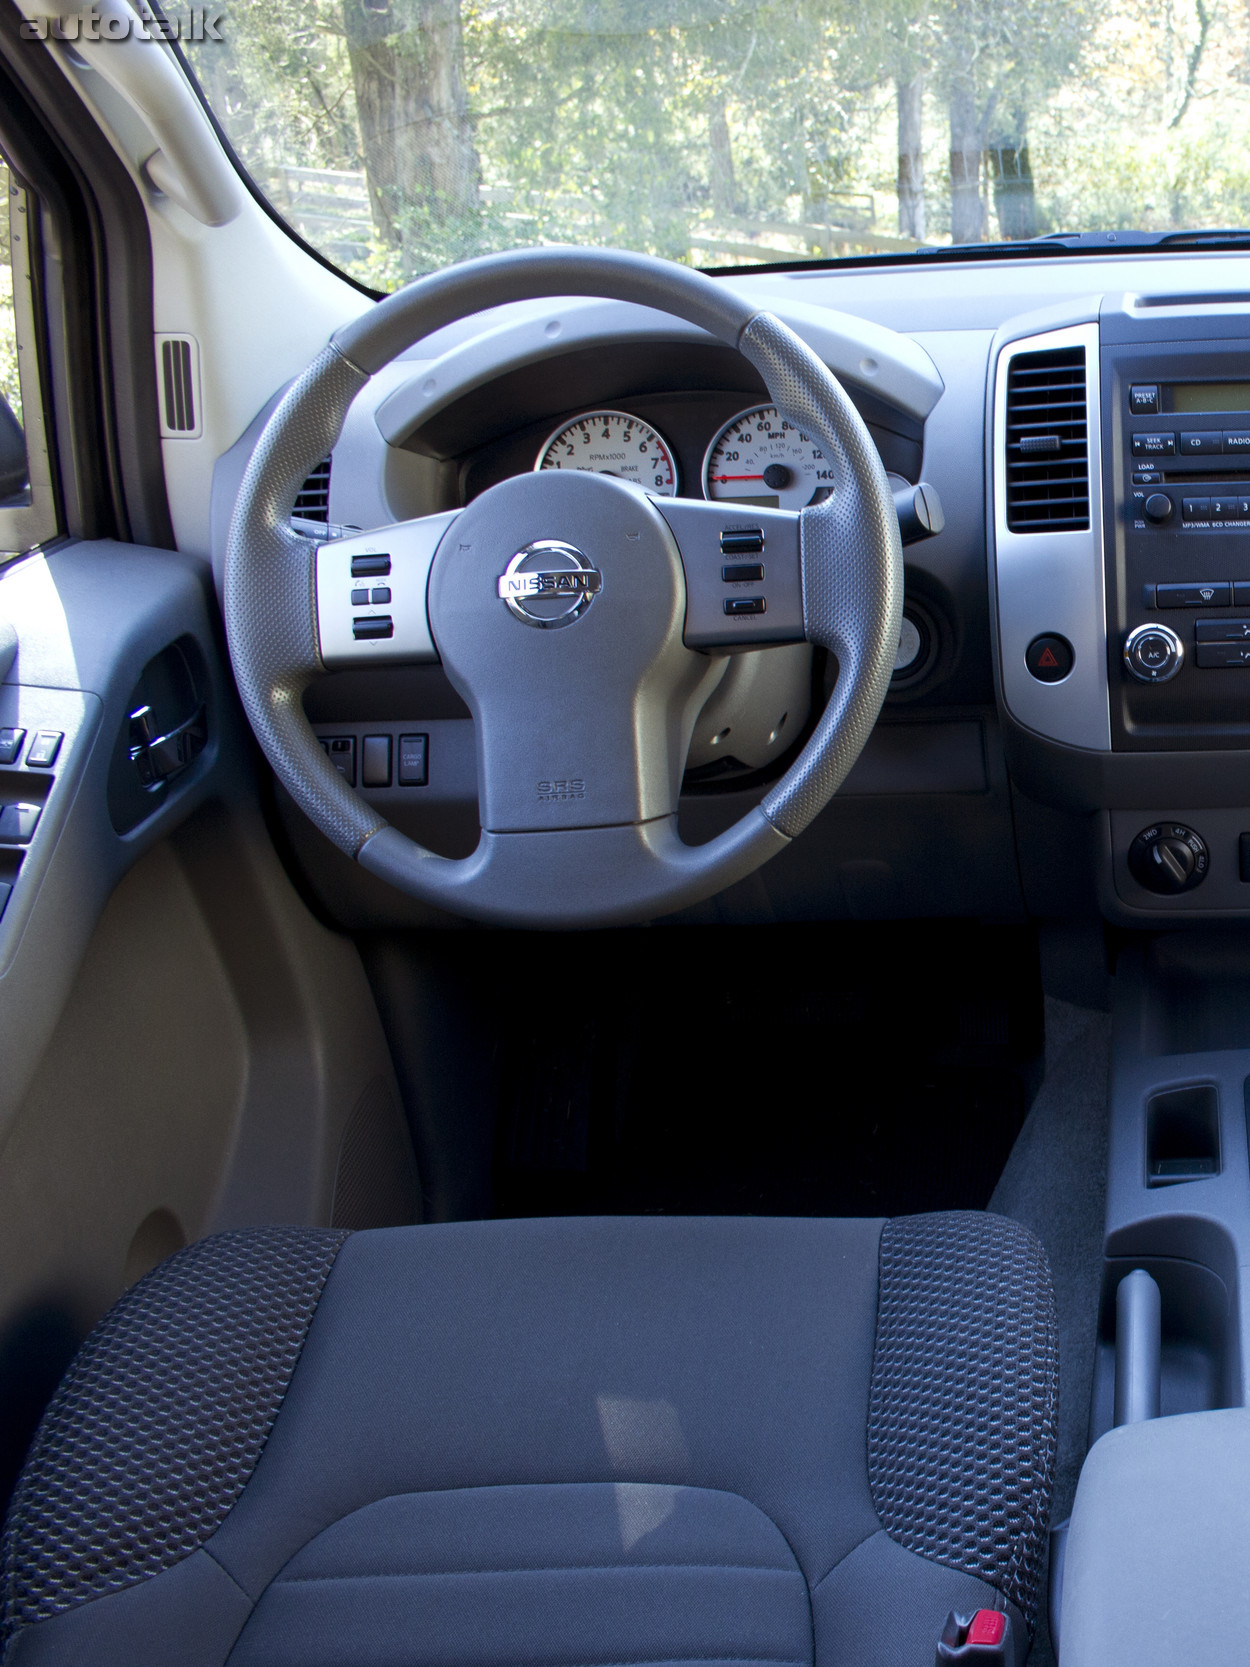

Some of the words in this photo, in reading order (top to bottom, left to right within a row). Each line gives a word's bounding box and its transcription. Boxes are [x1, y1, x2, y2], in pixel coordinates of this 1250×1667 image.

[757, 422, 771, 431] 60
[583, 433, 591, 444] 3
[602, 428, 610, 439] 4
[623, 431, 631, 442] 5
[738, 433, 752, 443] 40
[566, 444, 575, 456] 2
[639, 441, 648, 453] 6
[589, 453, 626, 461] RPMx1000
[725, 451, 740, 462] 20
[650, 457, 660, 470] 7
[654, 475, 664, 487] 8
[1189, 504, 1193, 512] 1
[1216, 503, 1221, 512] 2
[1243, 503, 1249, 512] 3
[508, 574, 589, 592] NISSAN
[537, 780, 586, 793] SRS
[1142, 828, 1158, 841] 2WD
[1174, 828, 1186, 836] 4H
[1187, 839, 1200, 854] PUSH
